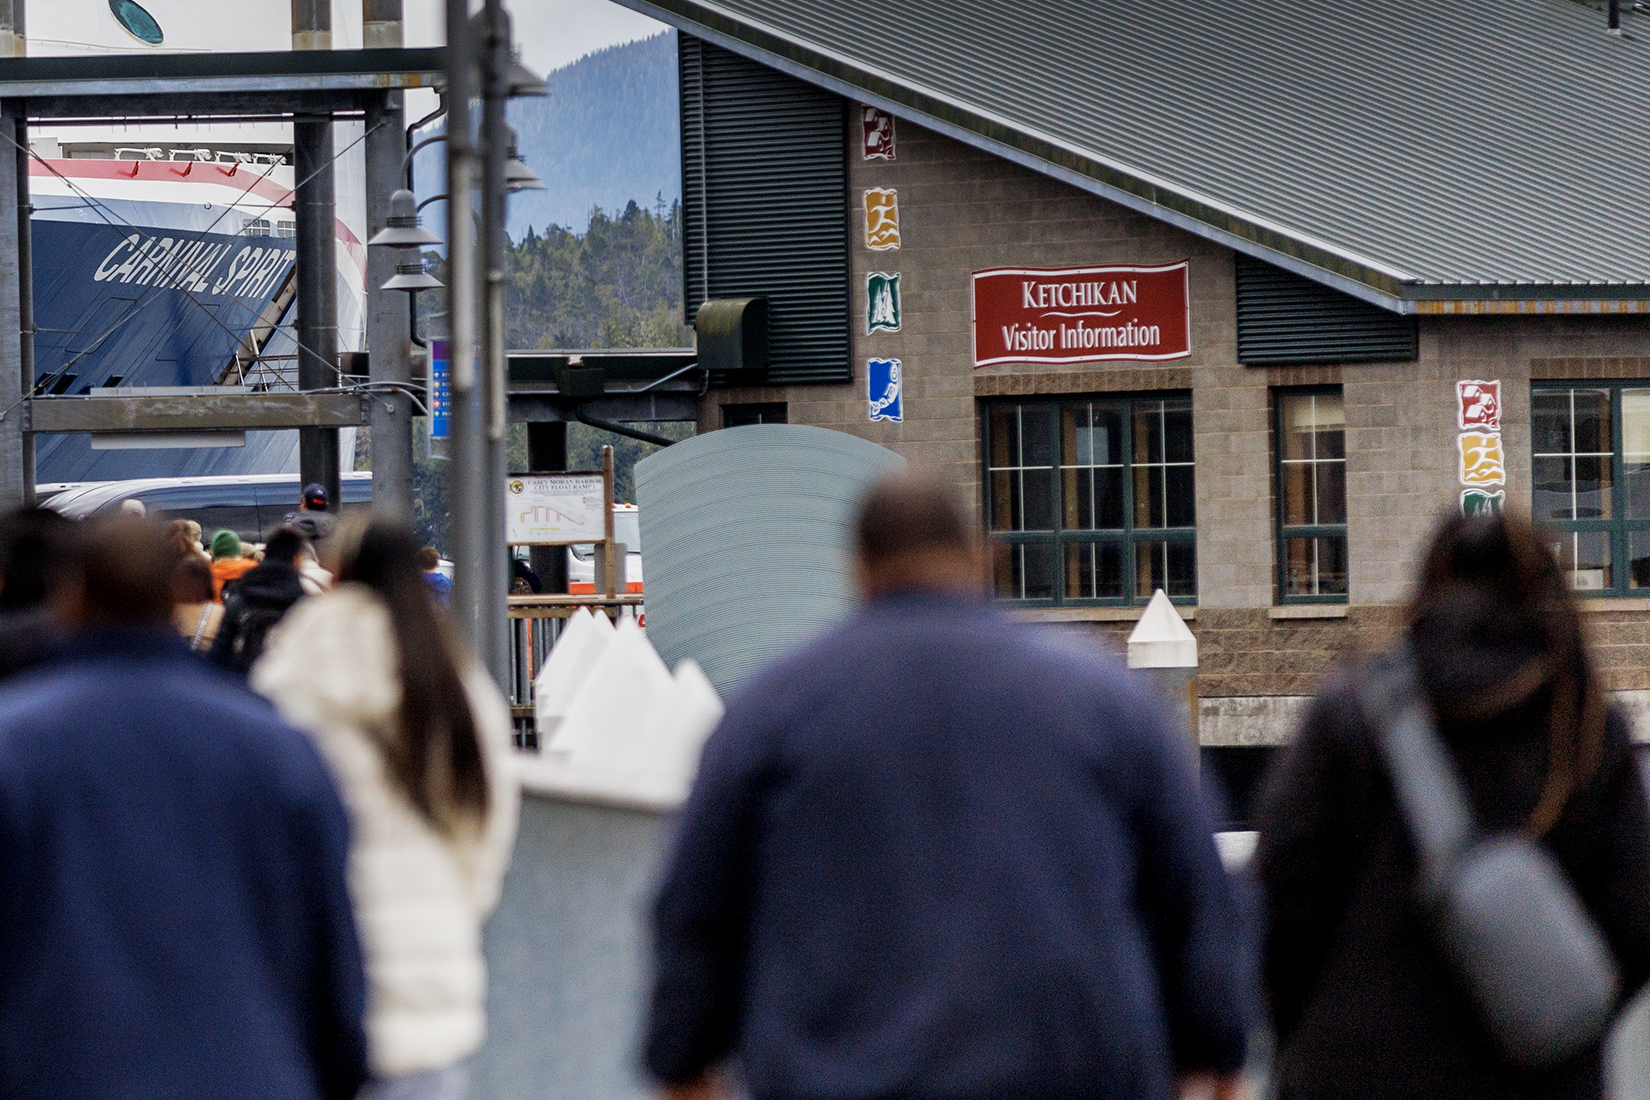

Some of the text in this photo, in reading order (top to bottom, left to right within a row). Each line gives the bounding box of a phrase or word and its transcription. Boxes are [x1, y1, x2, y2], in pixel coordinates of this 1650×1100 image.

[93, 233, 296, 299] CARNIVAL SPIRIT
[1022, 280, 1138, 308] KETCHIKAN
[1002, 318, 1160, 350] Visitor Information
